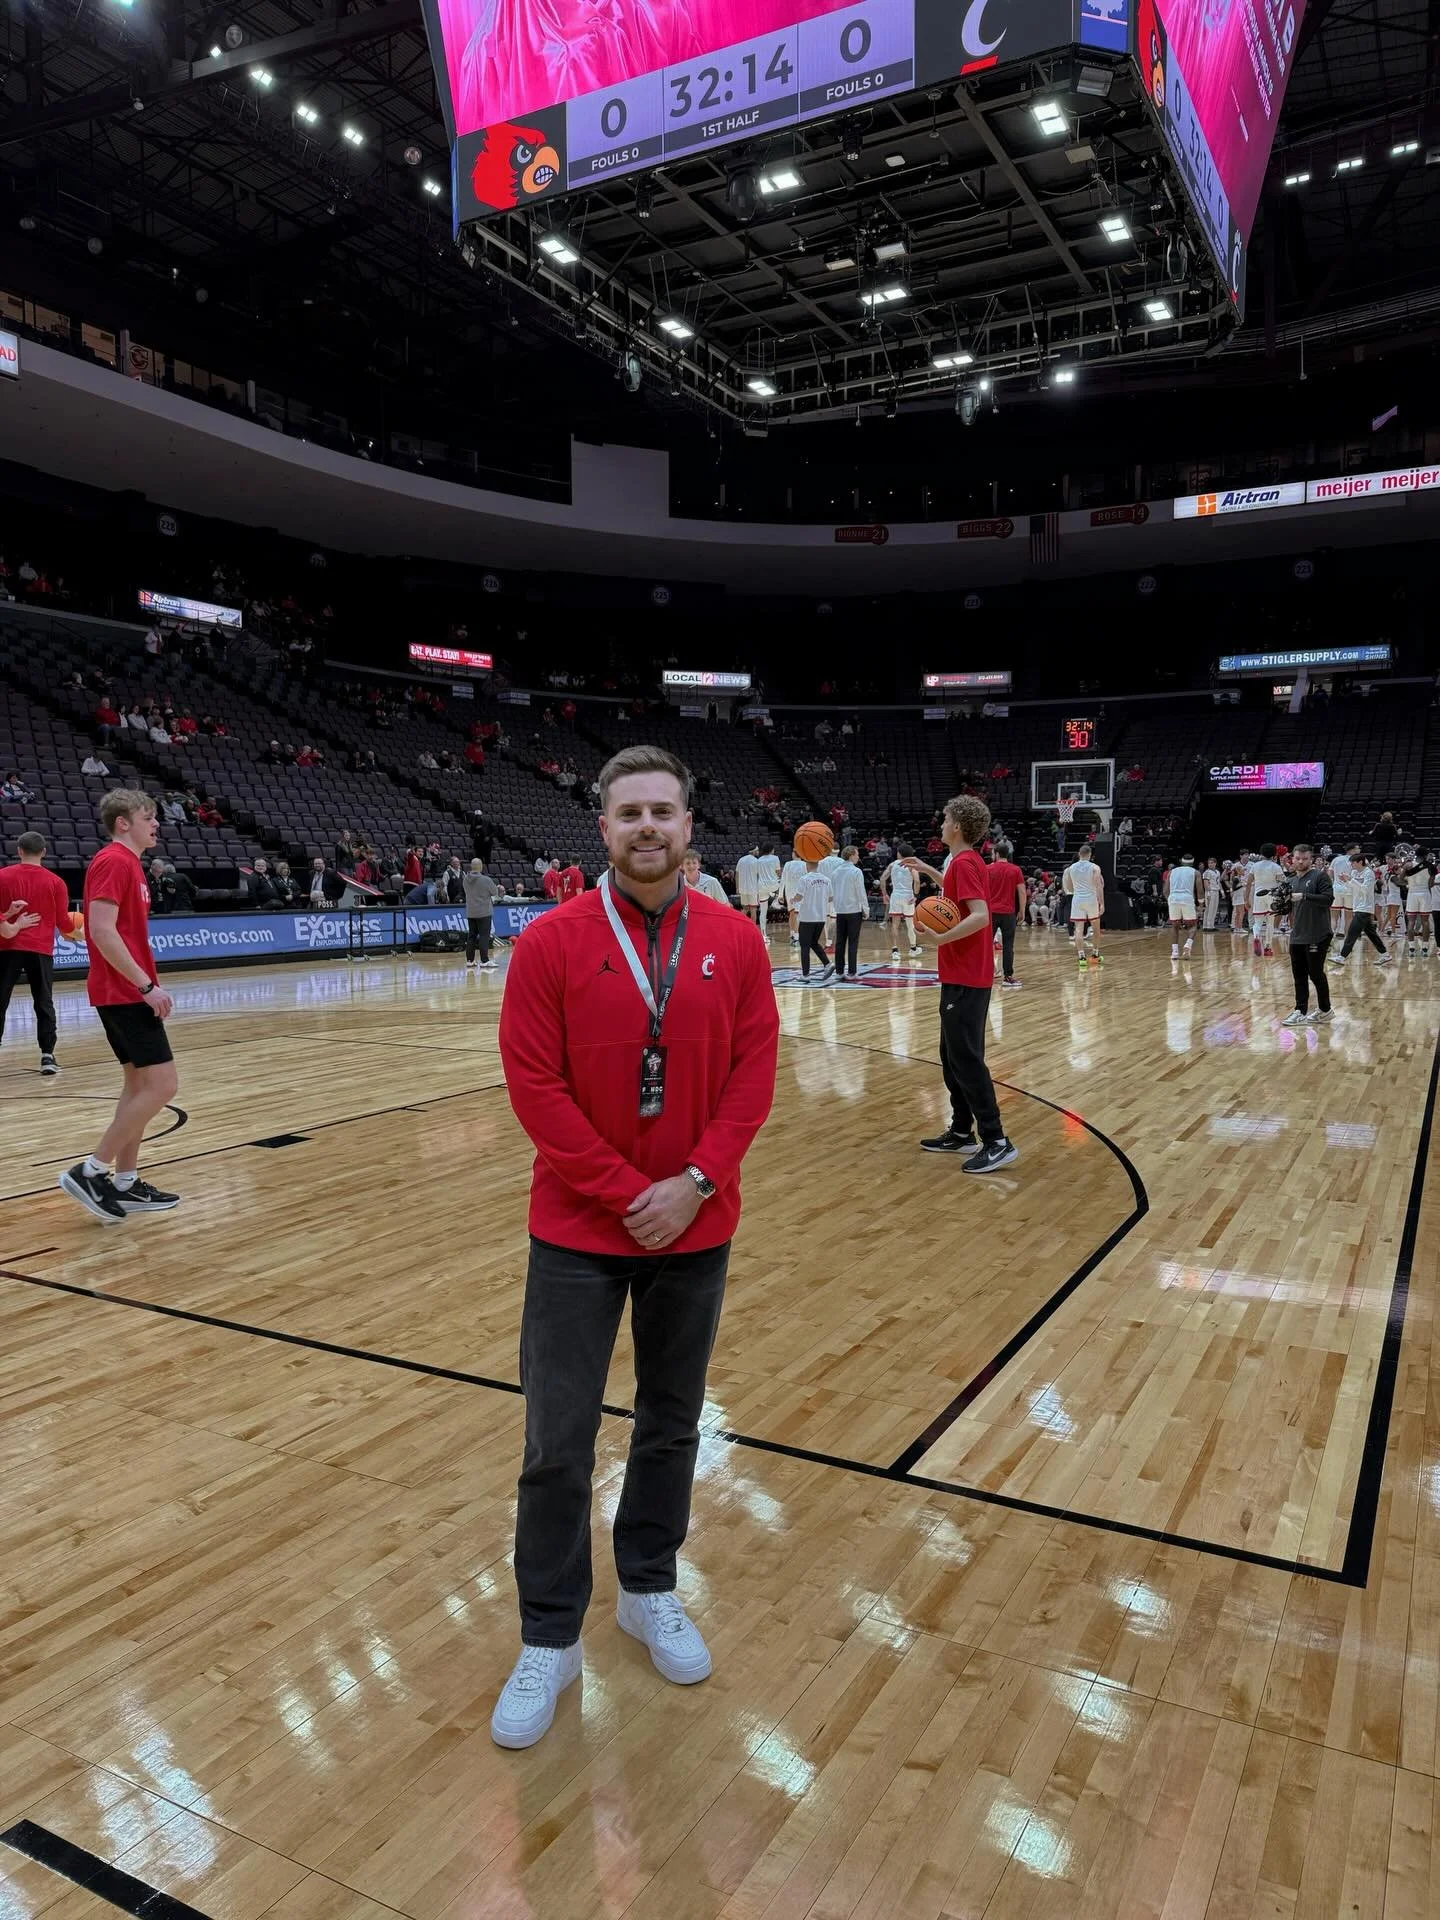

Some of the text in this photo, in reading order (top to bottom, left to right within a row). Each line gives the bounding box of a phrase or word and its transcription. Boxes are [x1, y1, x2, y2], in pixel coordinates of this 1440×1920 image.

[839, 18, 872, 64] 0
[670, 43, 794, 118] 32:14
[825, 73, 884, 102] FOULS 0
[600, 98, 627, 138] 0
[701, 109, 760, 138] 1ST HALF
[591, 147, 640, 171] FOULS 0
[1317, 469, 1440, 497] meijer meijer
[665, 673, 701, 682] LOCAL
[714, 675, 750, 685] NEWS
[1065, 720, 1093, 732] 32:14
[1068, 731, 1089, 749] 30
[1209, 765, 1259, 776] CARDI
[405, 915, 443, 935] Now
[933, 904, 954, 922] NCAA
